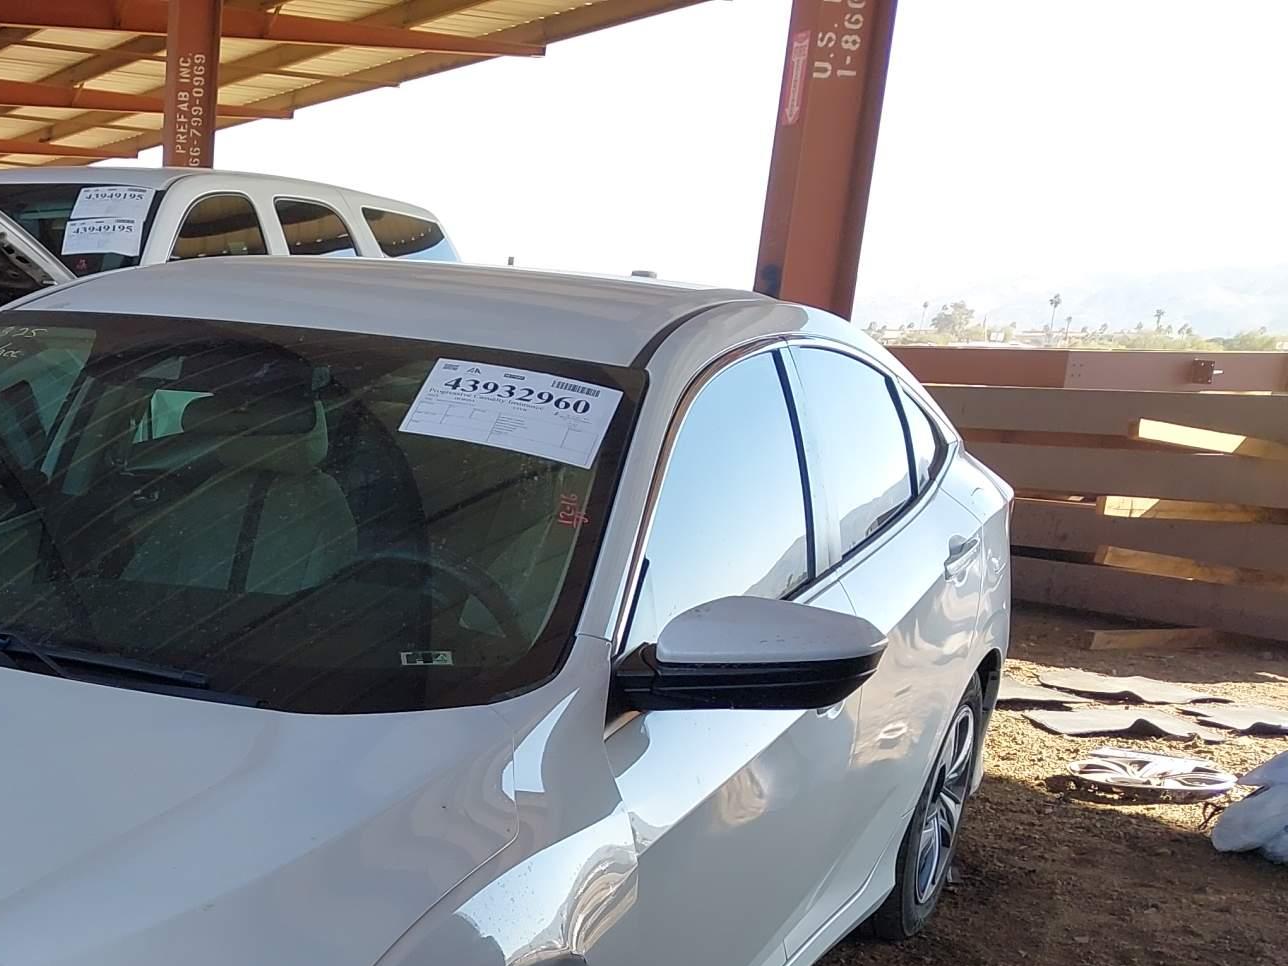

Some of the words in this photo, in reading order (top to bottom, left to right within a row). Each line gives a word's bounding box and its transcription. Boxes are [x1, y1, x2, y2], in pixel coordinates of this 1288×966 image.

[178, 52, 193, 82] INC.
[175, 91, 191, 154] PREFAB
[444, 376, 590, 414] 43932960
